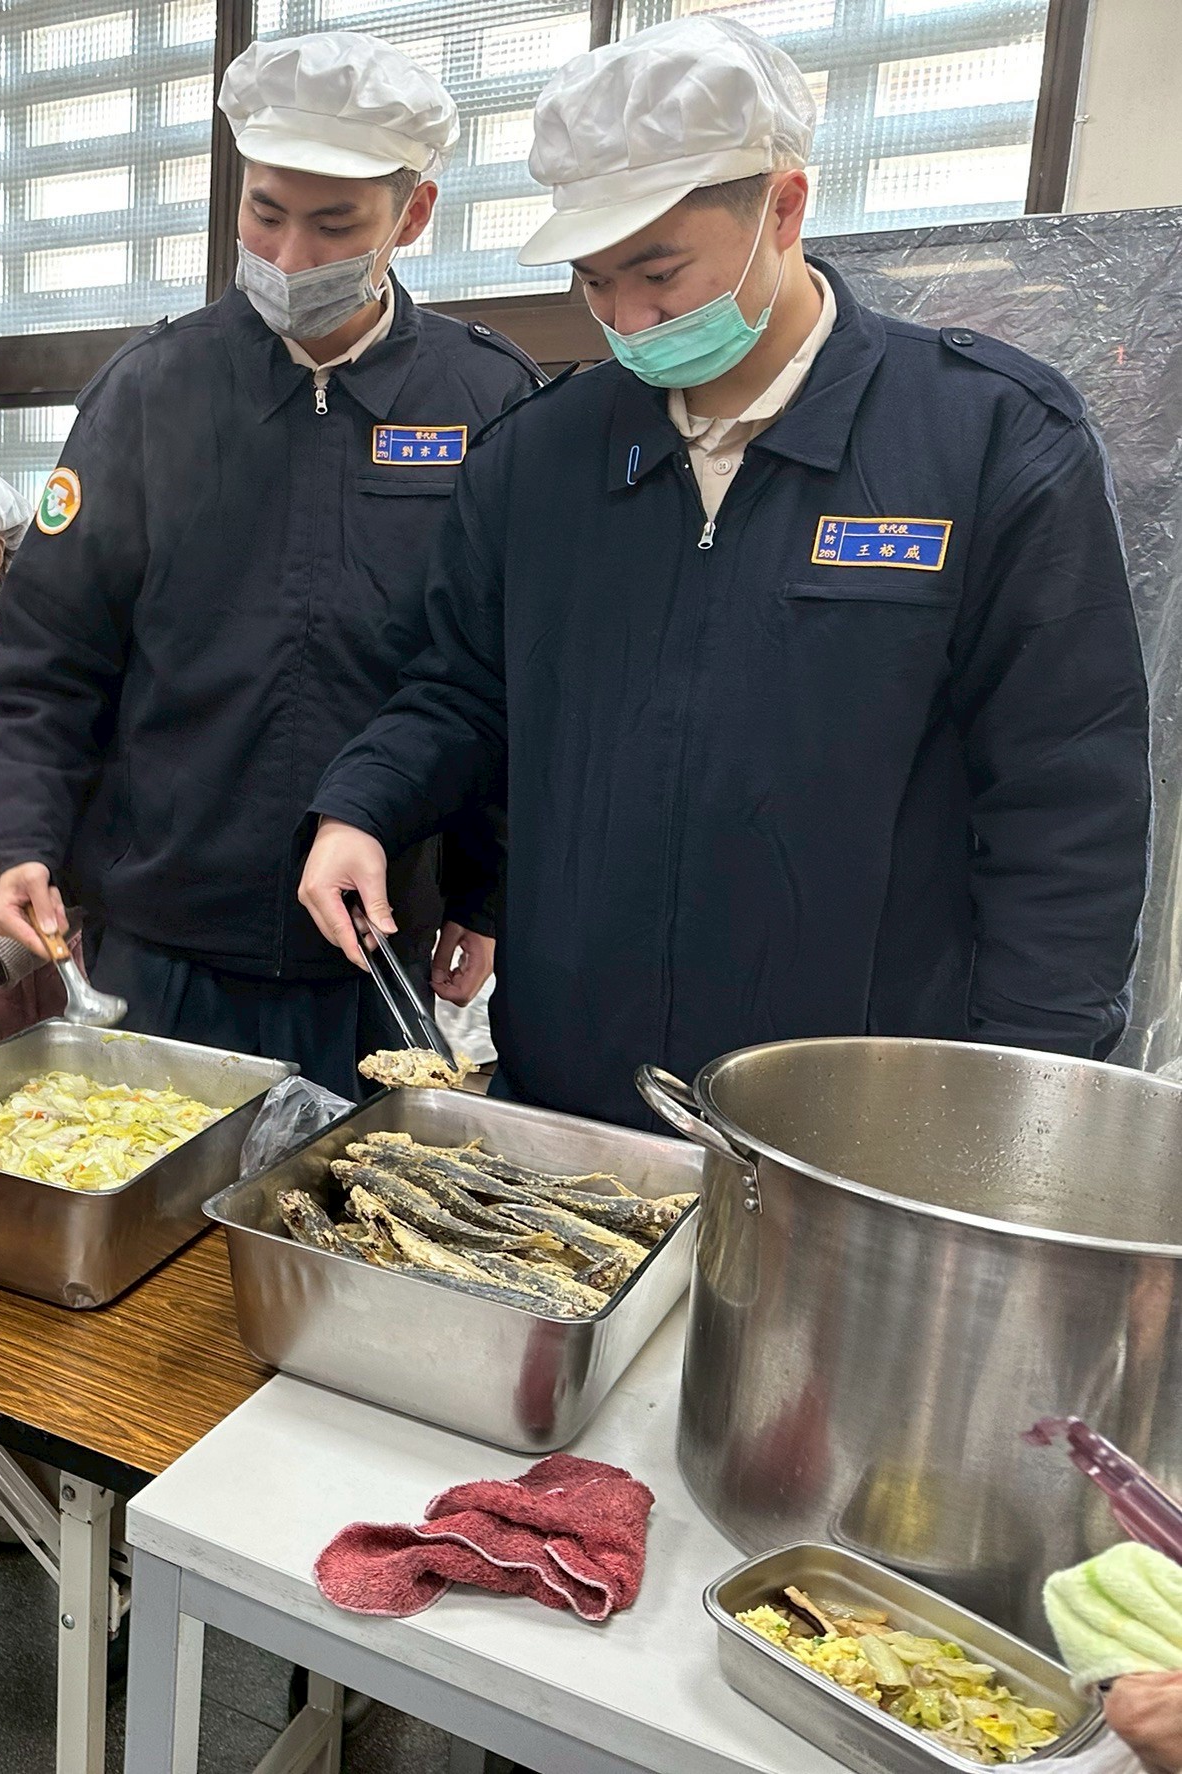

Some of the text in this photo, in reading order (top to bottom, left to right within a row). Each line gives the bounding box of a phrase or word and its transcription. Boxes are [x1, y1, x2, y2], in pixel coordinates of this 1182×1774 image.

[878, 523, 909, 534] 替代役
[819, 523, 838, 559] 民防 269
[856, 543, 921, 561] 王裕威
